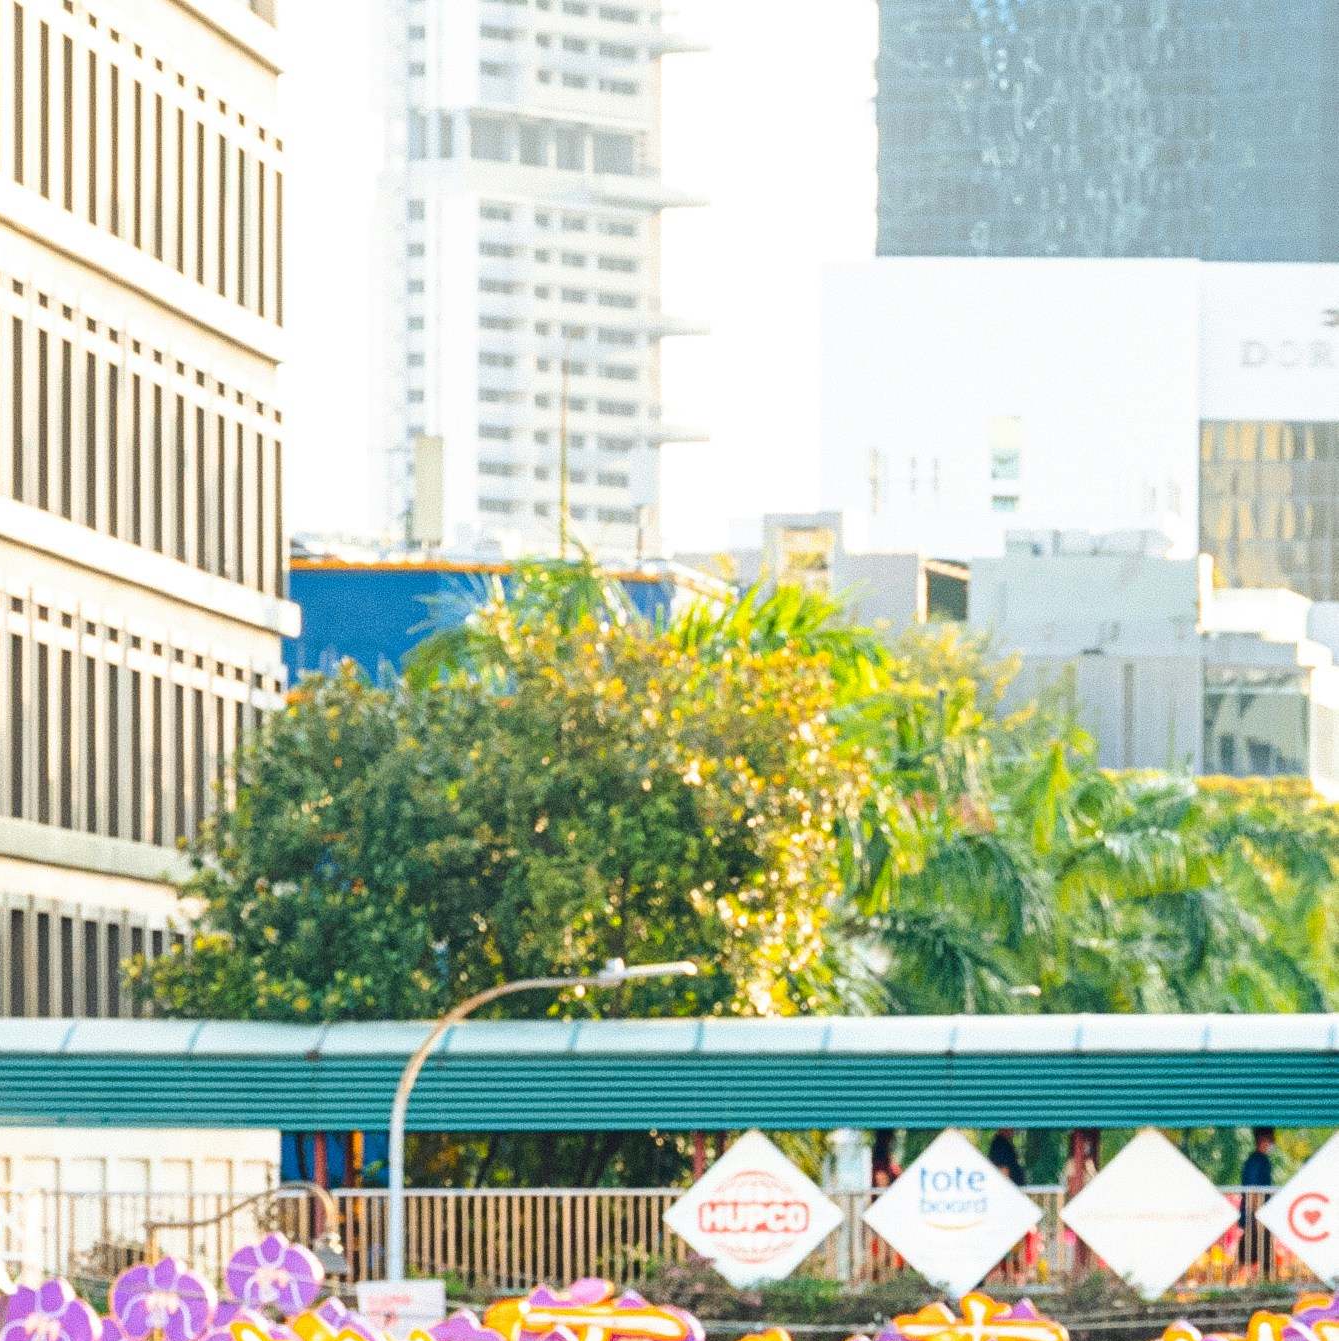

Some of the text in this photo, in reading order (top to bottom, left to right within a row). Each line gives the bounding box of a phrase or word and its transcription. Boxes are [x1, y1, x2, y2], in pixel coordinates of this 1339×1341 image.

[919, 1167, 987, 1193] tote
[700, 1203, 809, 1233] HUPCO
[919, 1199, 989, 1215] board
